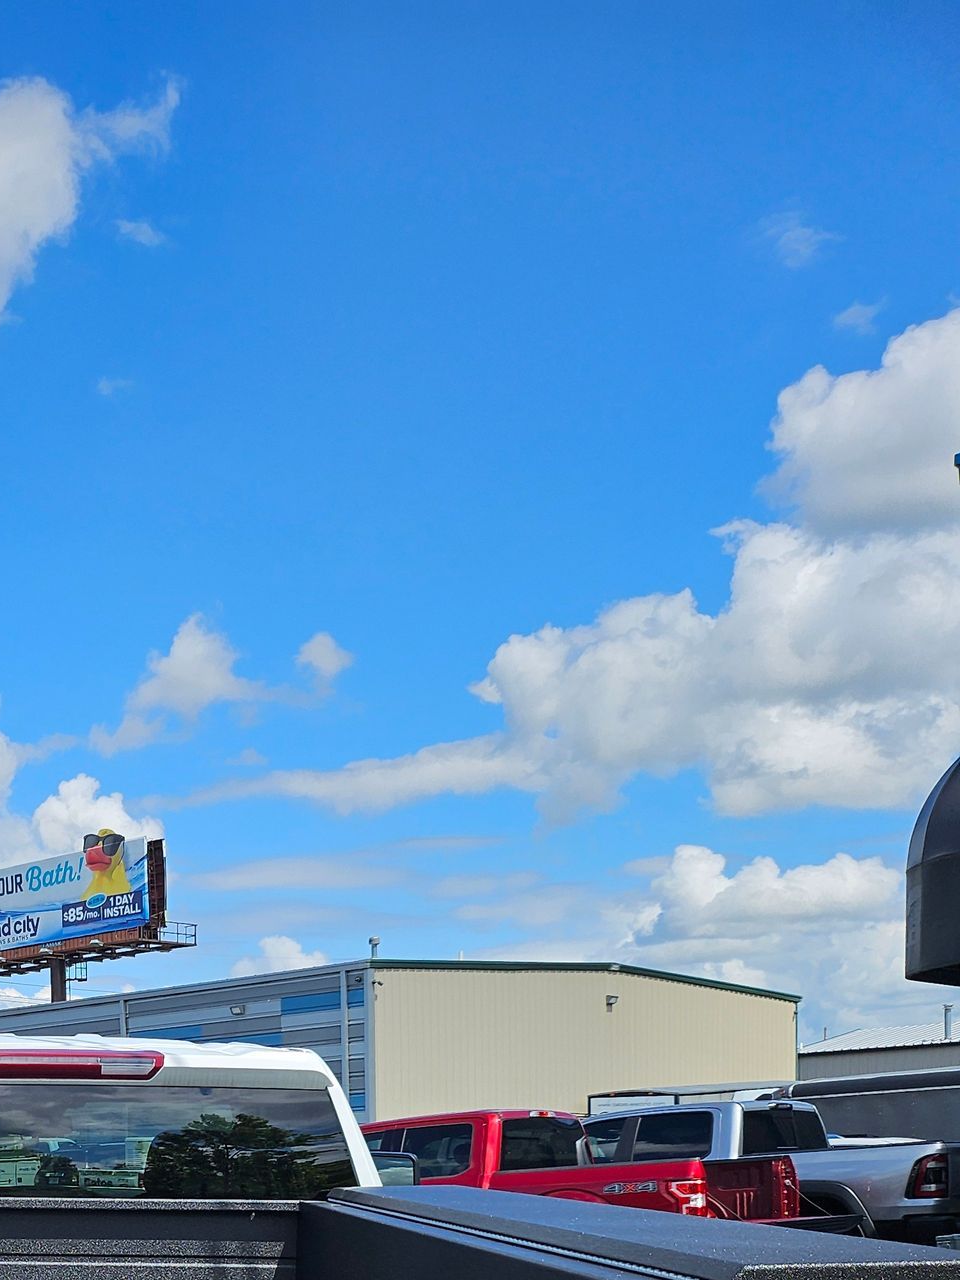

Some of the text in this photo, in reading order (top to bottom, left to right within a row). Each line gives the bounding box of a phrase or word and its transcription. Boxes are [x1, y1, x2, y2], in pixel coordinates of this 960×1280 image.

[26, 856, 84, 892] Bath!
[115, 893, 135, 906] DAY
[103, 903, 142, 918] INSTALL
[13, 915, 40, 937] city
